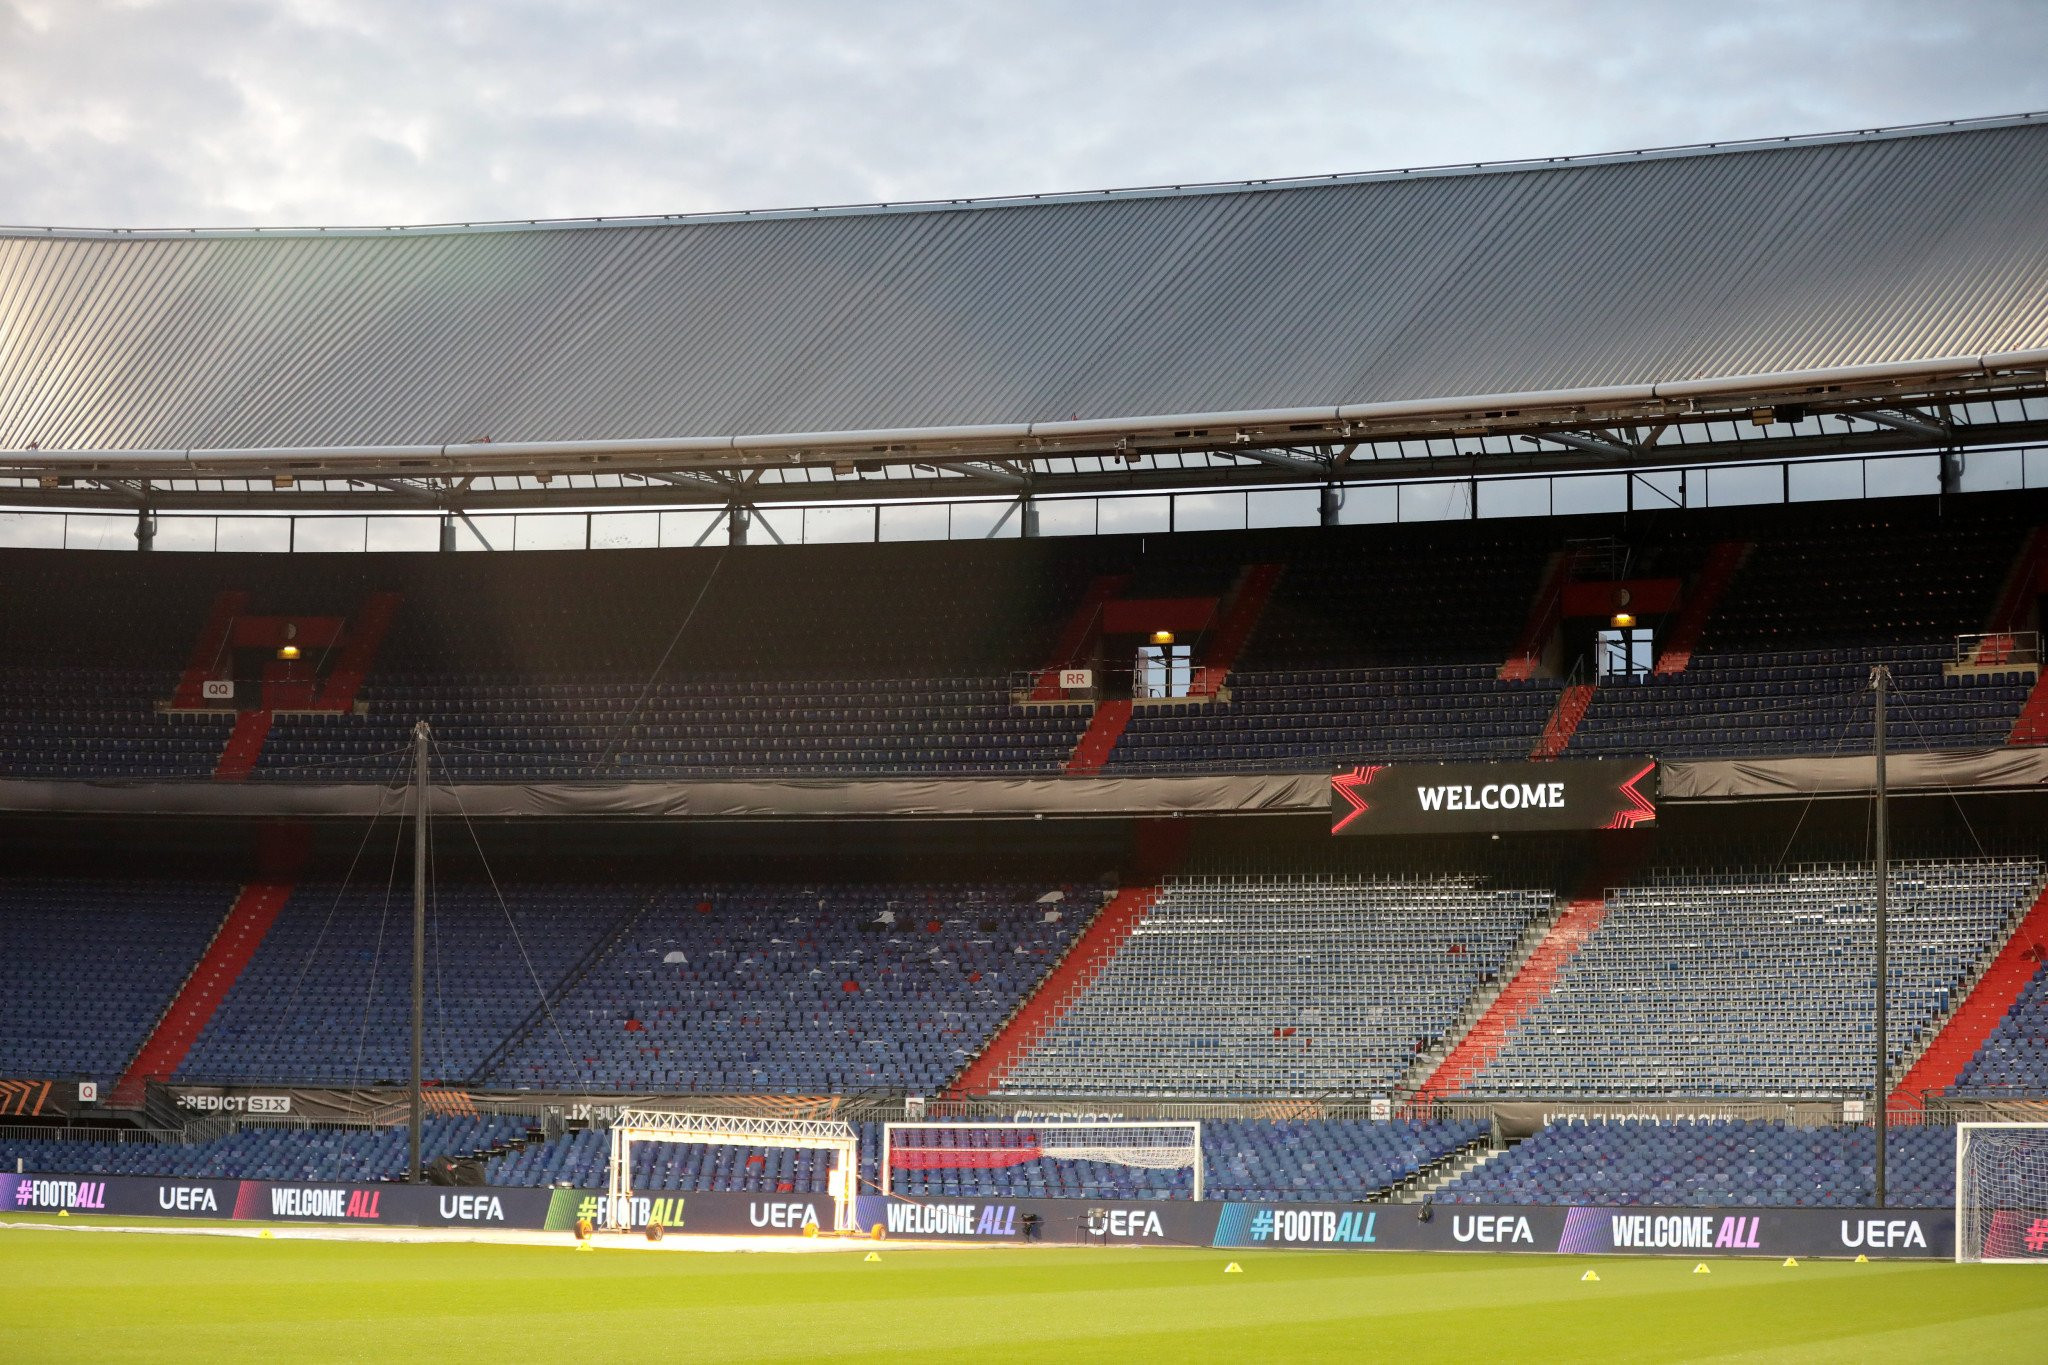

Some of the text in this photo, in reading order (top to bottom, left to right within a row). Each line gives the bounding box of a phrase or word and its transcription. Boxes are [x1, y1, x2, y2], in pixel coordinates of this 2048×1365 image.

[208, 684, 228, 695] QQ
[1066, 673, 1085, 685] RR
[1416, 783, 1565, 811] WELCOME
[82, 1085, 93, 1099] Q
[251, 1097, 287, 1111] SIX
[16, 1180, 106, 1209] #FOOTBALL
[159, 1186, 218, 1212] UEFA
[271, 1187, 381, 1218] WELCOME ALL
[439, 1195, 505, 1221] UEFA
[750, 1202, 820, 1229] UEFA
[886, 1203, 1016, 1236] WELCOME ALL
[1087, 1209, 1164, 1237] UEFA
[1250, 1210, 1377, 1243] #FOOTBALL
[1453, 1215, 1535, 1243] UEFA
[1611, 1215, 1761, 1248] WELCOME ALL
[1841, 1219, 1928, 1248] UEFA
